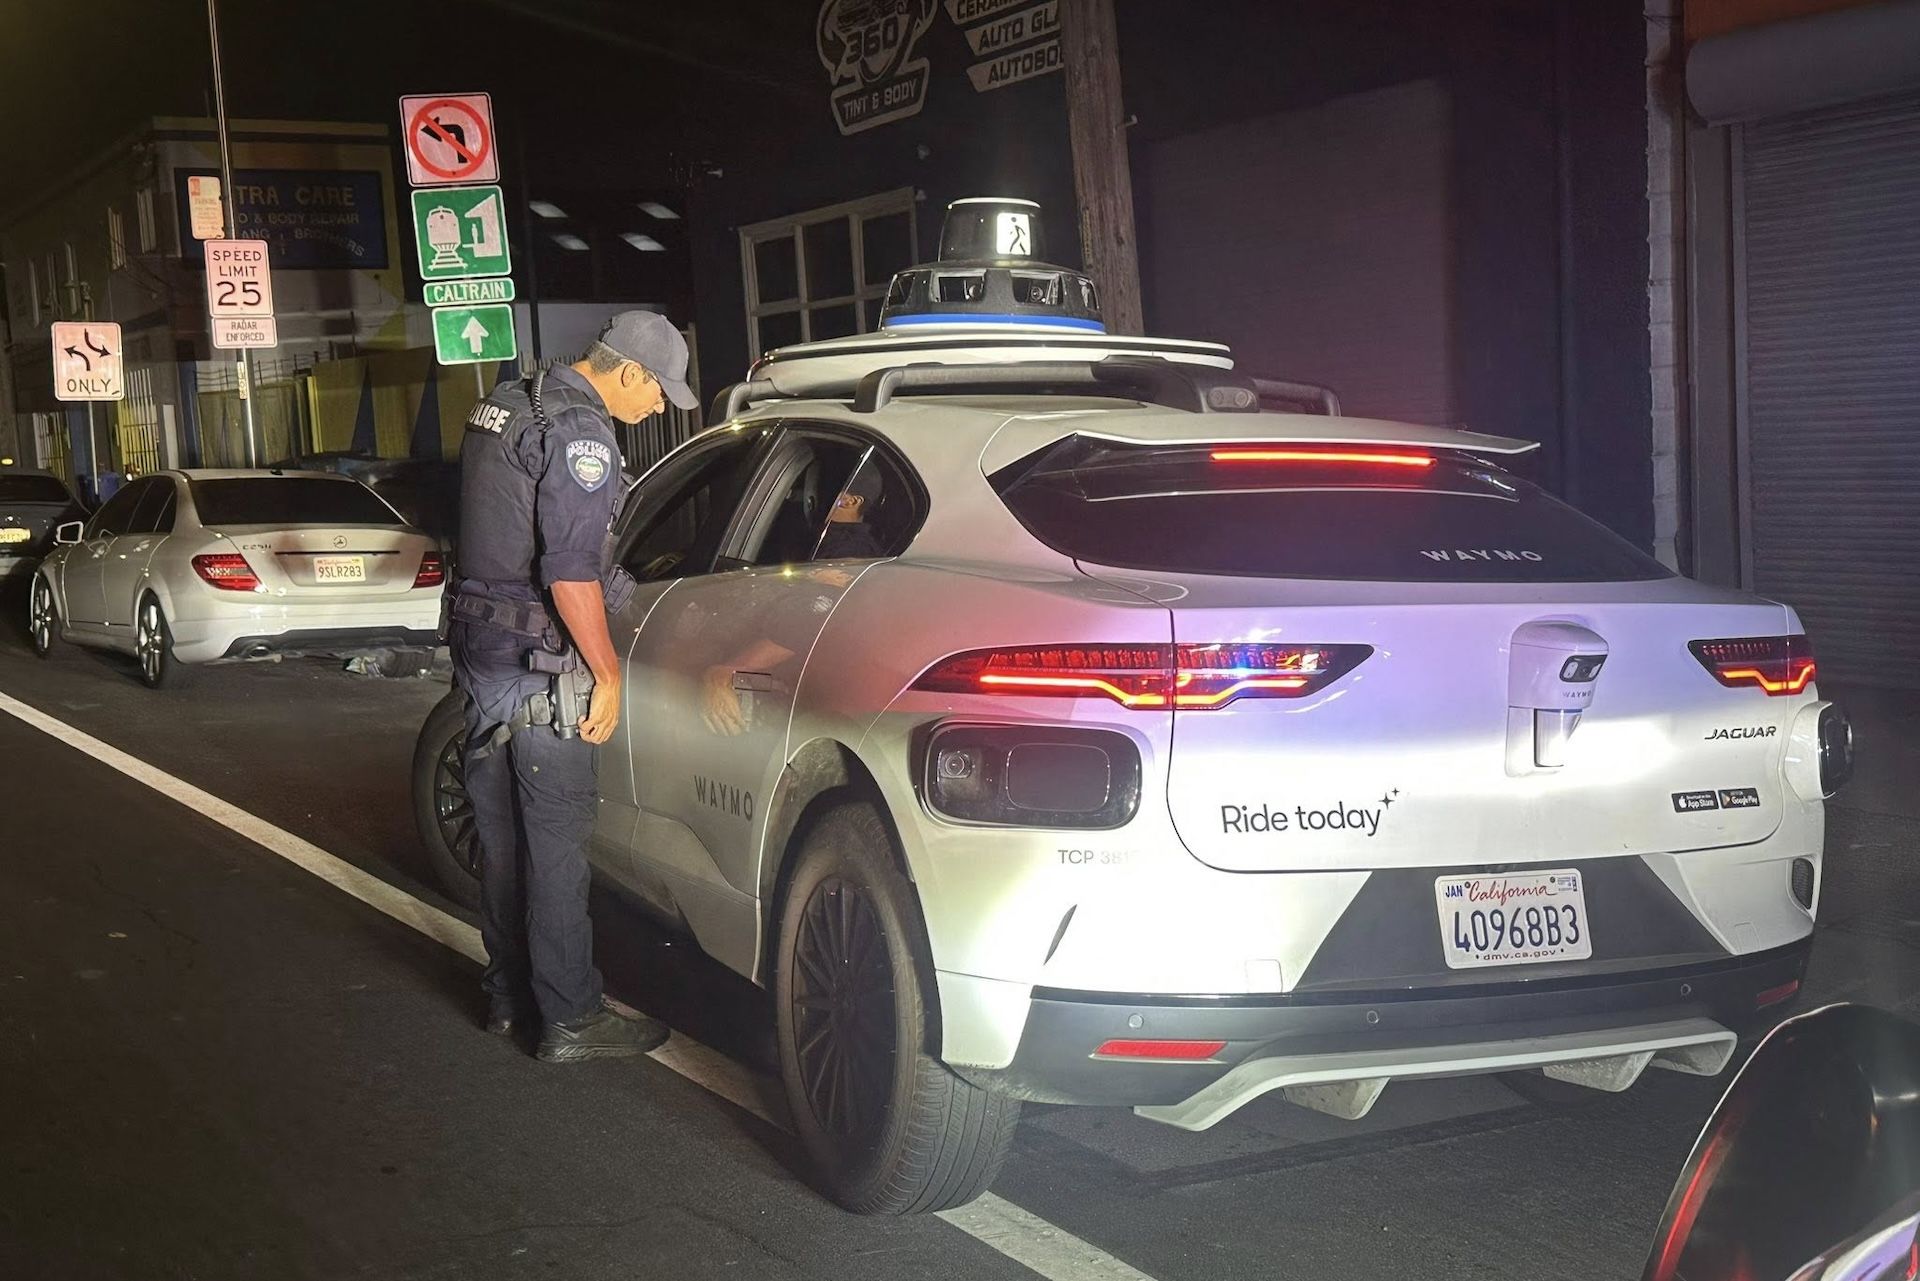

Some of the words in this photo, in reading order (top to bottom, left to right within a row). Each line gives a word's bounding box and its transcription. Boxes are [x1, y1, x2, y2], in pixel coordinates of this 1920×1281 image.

[846, 16, 899, 64] 360
[979, 18, 1024, 50] AUTO
[843, 95, 869, 120] TINT
[872, 92, 880, 110] &
[884, 79, 917, 106] BODY
[295, 185, 356, 206] CARE
[268, 213, 306, 224] BODY
[213, 250, 262, 261] SPEED
[219, 266, 257, 277] LIMIT
[216, 281, 261, 306] 25
[433, 281, 506, 302] CALTRAIN
[231, 321, 258, 330] RADAR
[226, 332, 265, 342] ENFORCED
[66, 378, 112, 393] ONLY
[1420, 549, 1543, 562] WAYMO
[1704, 726, 1777, 740] JAGUAR
[693, 774, 753, 821] WAYMO
[1221, 803, 1289, 834] Ride
[1295, 801, 1381, 837] today
[1057, 849, 1095, 865] TCP
[1445, 885, 1463, 898] JAN
[1468, 880, 1557, 906] California
[1454, 904, 1580, 952] 40968B3
[1483, 949, 1556, 961] dmv.ca.gov
